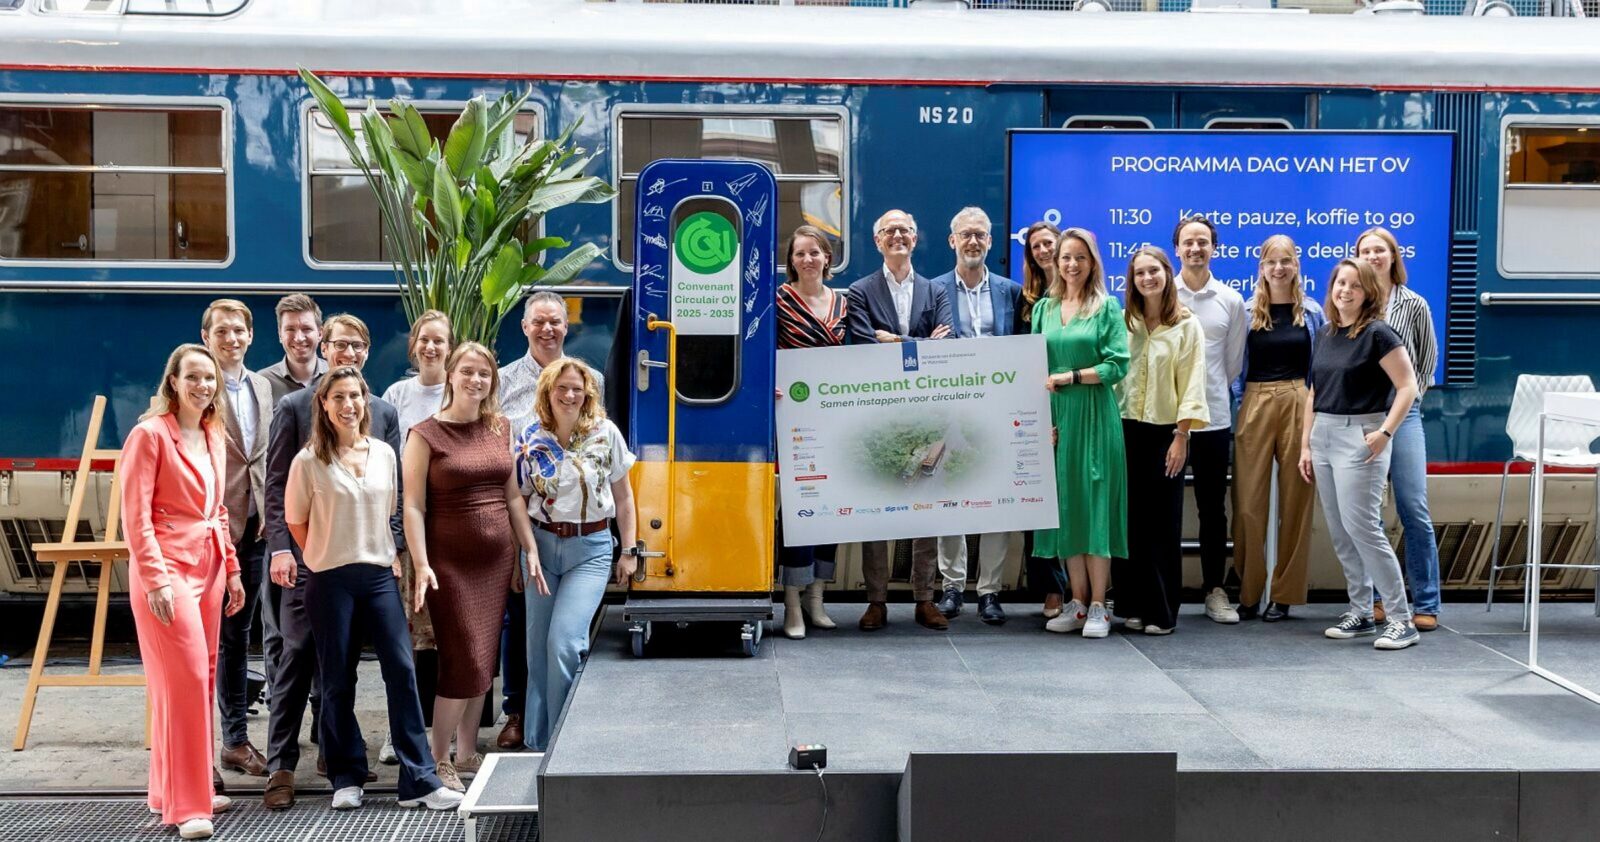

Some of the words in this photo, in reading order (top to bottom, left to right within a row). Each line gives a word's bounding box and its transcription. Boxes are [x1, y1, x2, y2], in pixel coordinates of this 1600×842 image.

[919, 106, 943, 124] NS
[947, 106, 973, 124] 20
[1111, 156, 1243, 173] PROGRAMMA
[1247, 156, 1289, 173] DAG
[1293, 156, 1334, 173] VAN
[1340, 156, 1378, 173] HET
[1381, 156, 1411, 173] OV
[1109, 208, 1153, 225] 11:30
[1180, 208, 1232, 225] Krte
[1238, 211, 1301, 229] pauze,
[1306, 208, 1360, 225] koffie
[1364, 210, 1385, 225] to
[1389, 212, 1416, 229] go
[1108, 241, 1152, 258] 11:4
[1245, 245, 1303, 258] roe
[677, 281, 734, 291] Convenant
[674, 295, 719, 304] Circulair
[721, 295, 737, 304] OV
[676, 308, 702, 318] 2025
[710, 308, 735, 318] 2035
[817, 378, 911, 396] Convenant
[915, 371, 987, 390] Circulair
[991, 370, 1017, 385] OV
[820, 399, 855, 409] Samen
[856, 395, 906, 407] instappen
[908, 394, 930, 403] voor
[931, 390, 971, 401] circulair
[973, 391, 985, 399] ov
